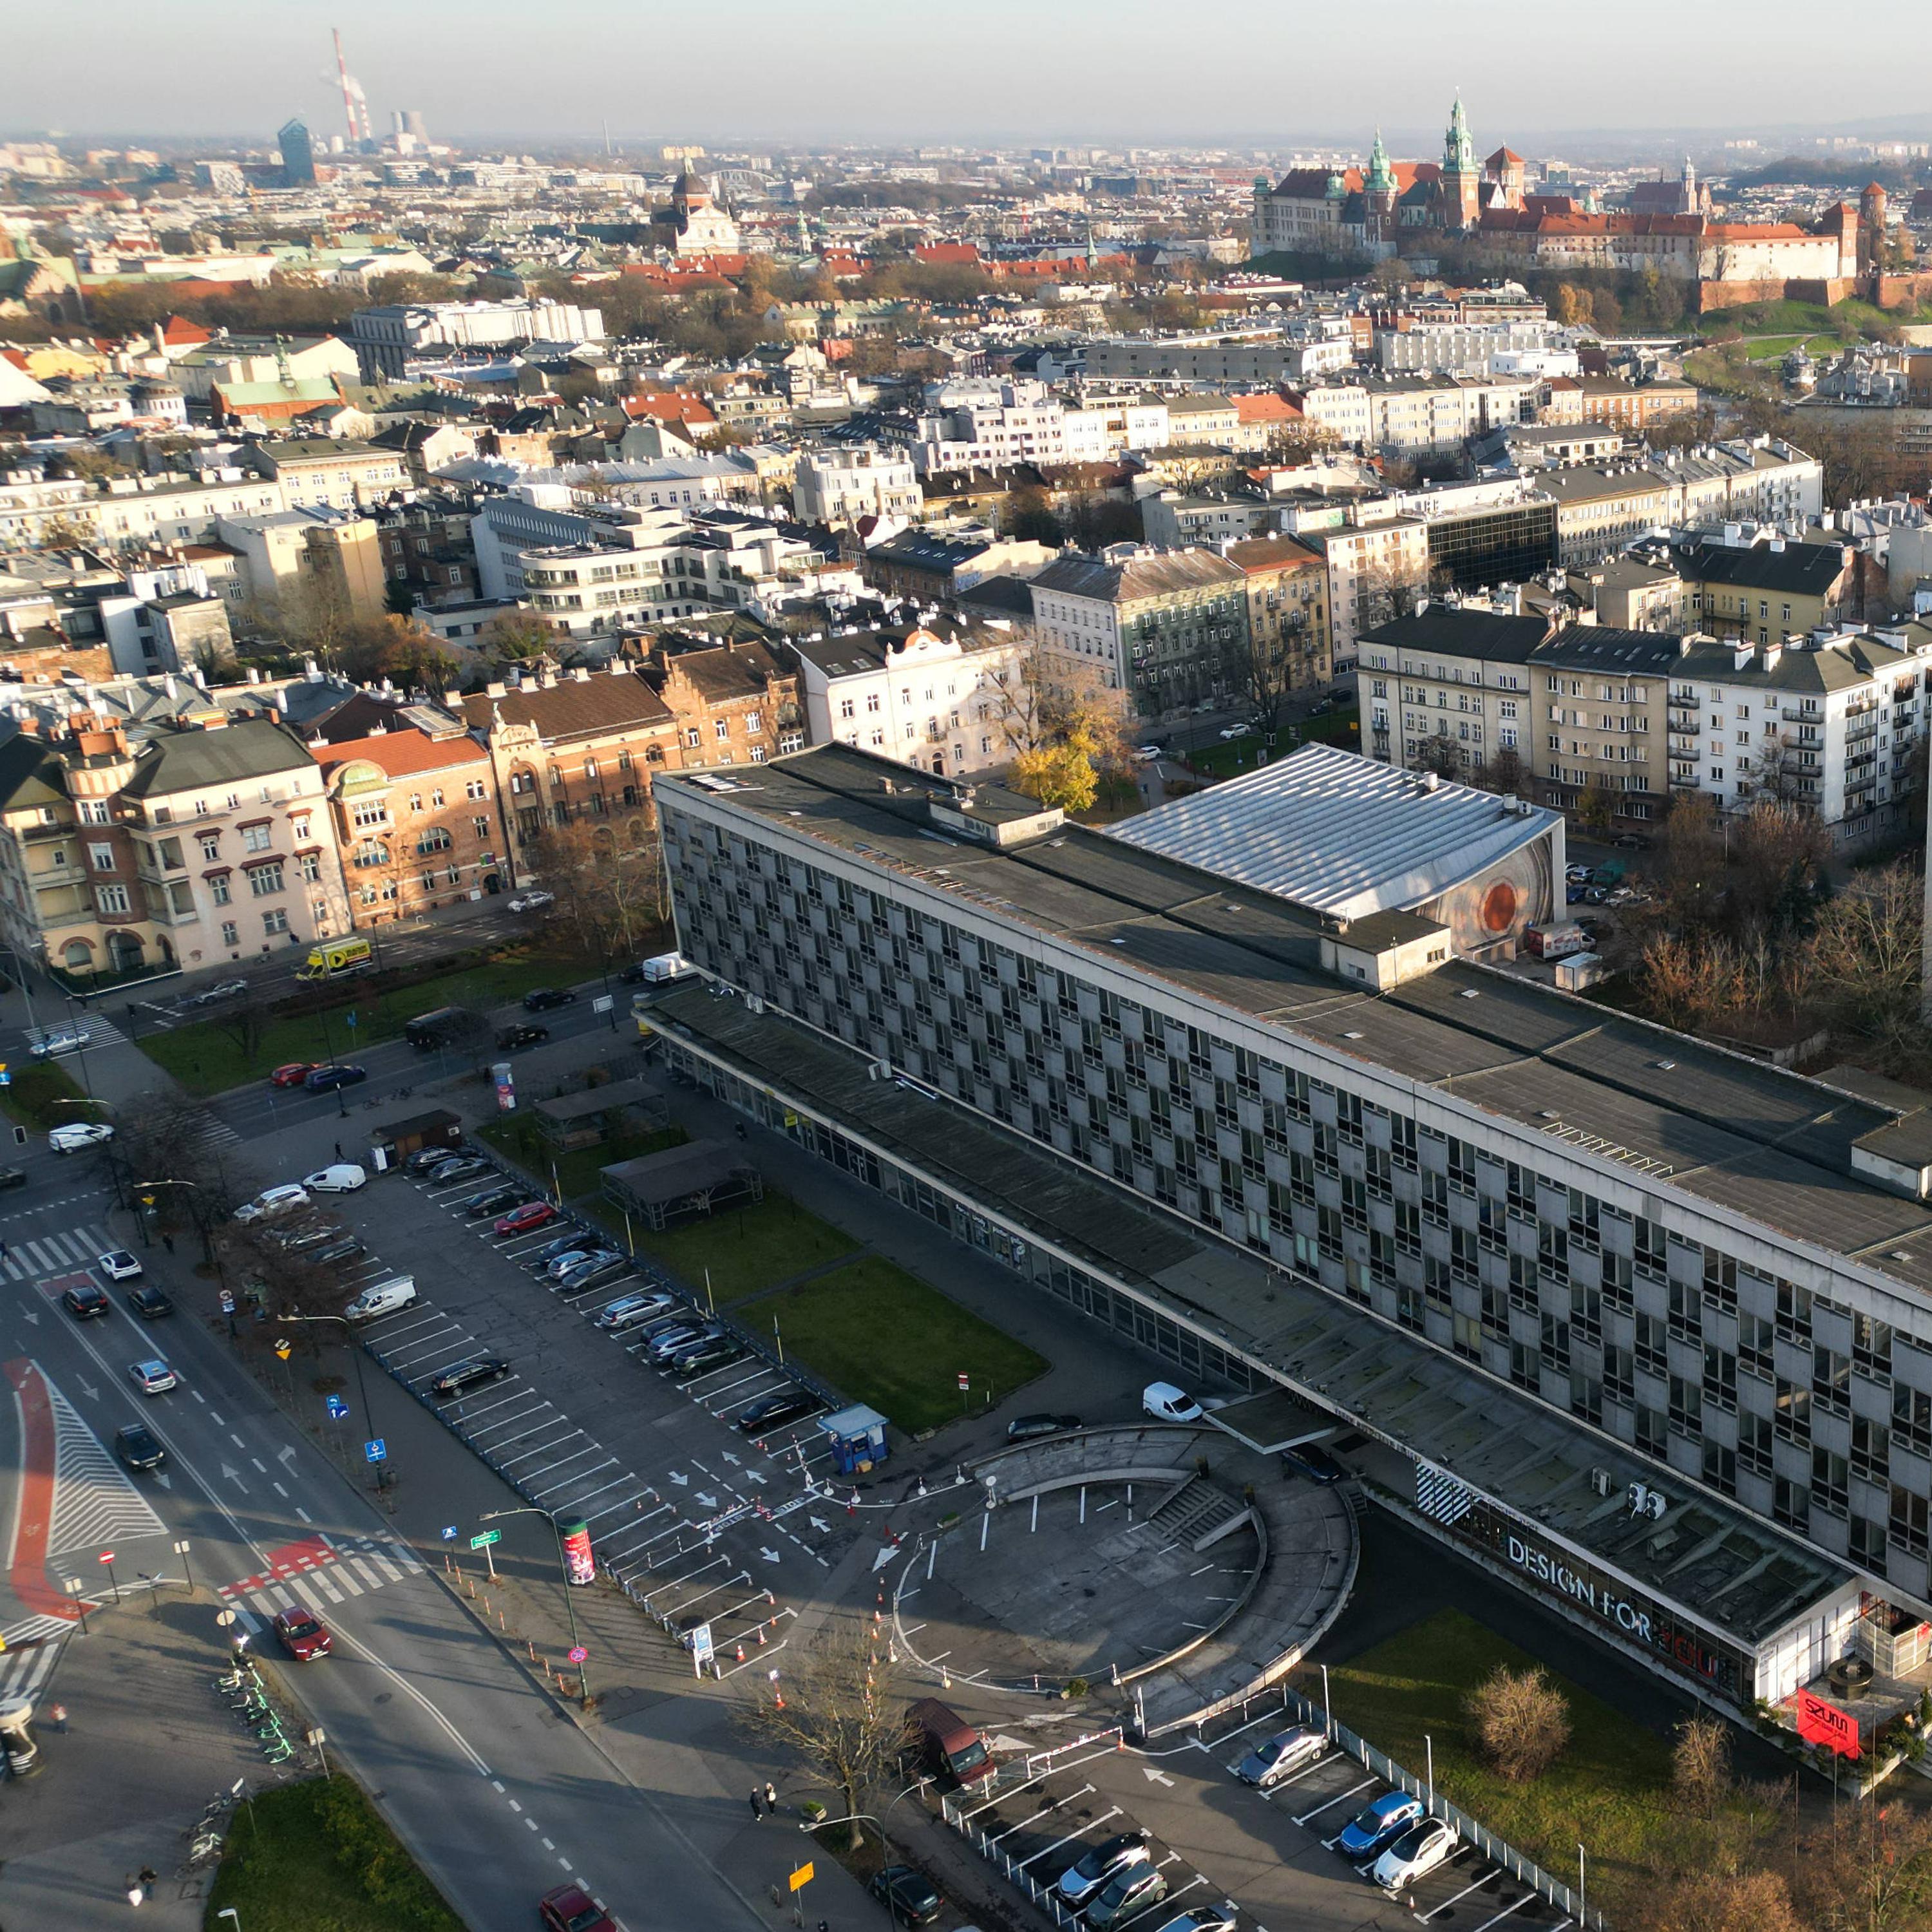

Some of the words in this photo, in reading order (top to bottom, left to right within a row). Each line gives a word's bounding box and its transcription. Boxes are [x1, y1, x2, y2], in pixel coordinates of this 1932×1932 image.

[714, 1514, 745, 1532] STOP
[1508, 1536, 1595, 1608] DESIGN
[1602, 1591, 1653, 1643] FOR
